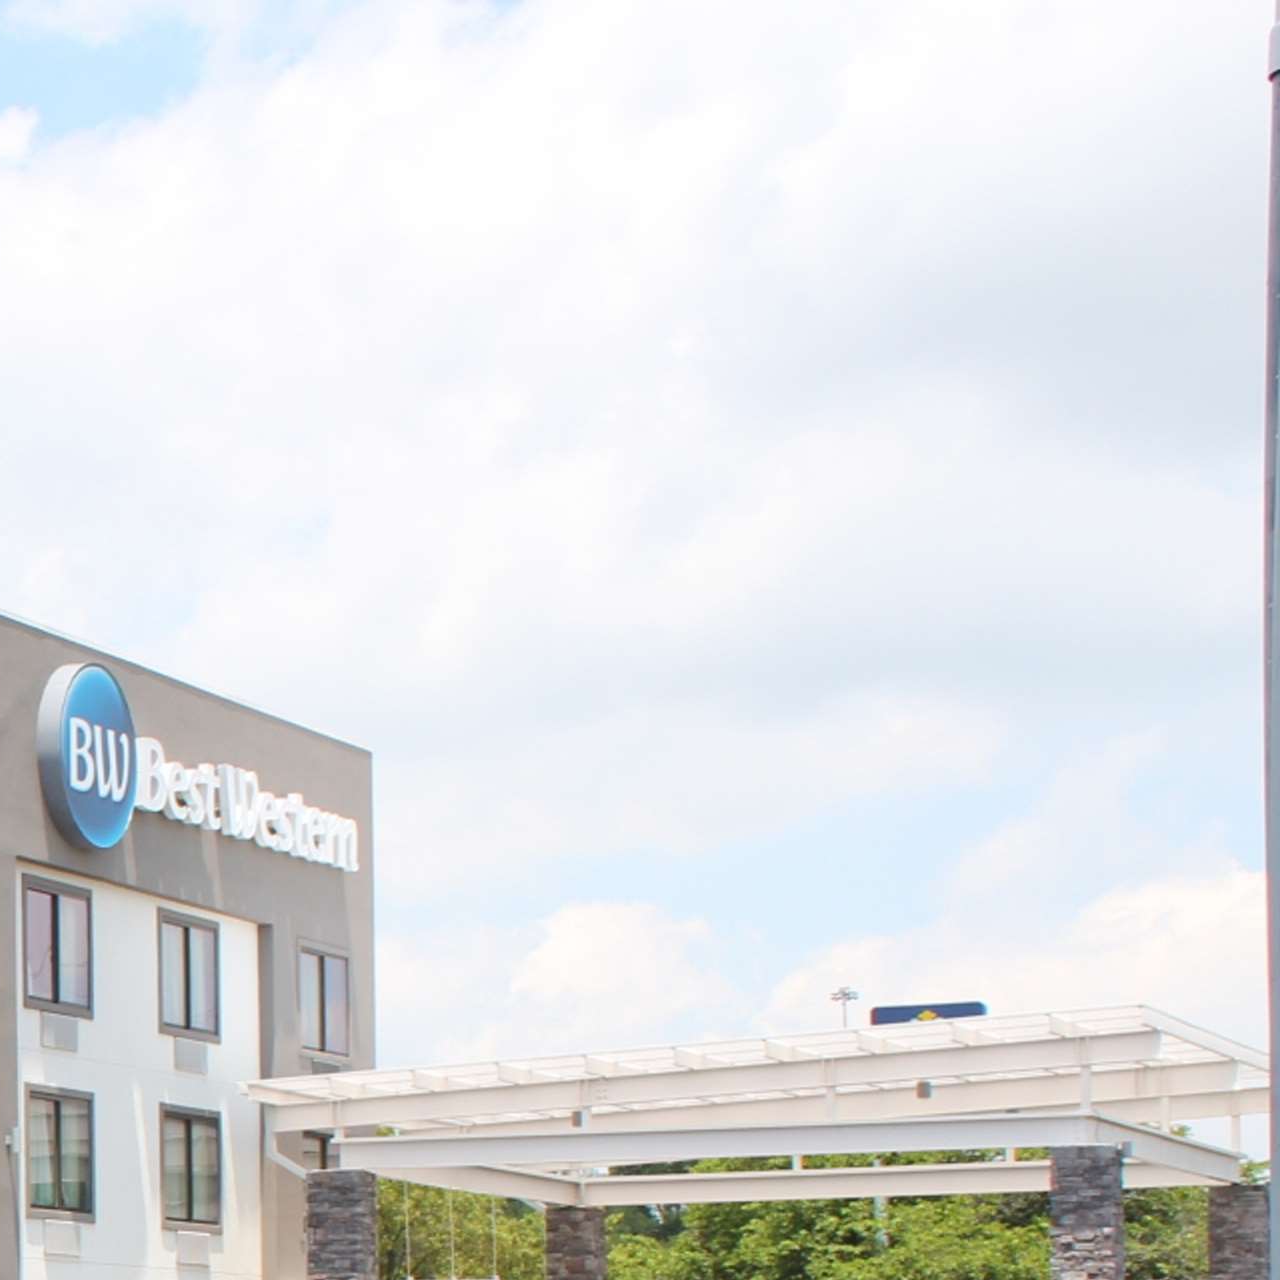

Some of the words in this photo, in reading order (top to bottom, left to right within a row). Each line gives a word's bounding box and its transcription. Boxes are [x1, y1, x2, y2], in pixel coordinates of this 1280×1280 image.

[68, 716, 130, 803] BW
[134, 737, 221, 831] Best
[217, 762, 359, 872] Western
